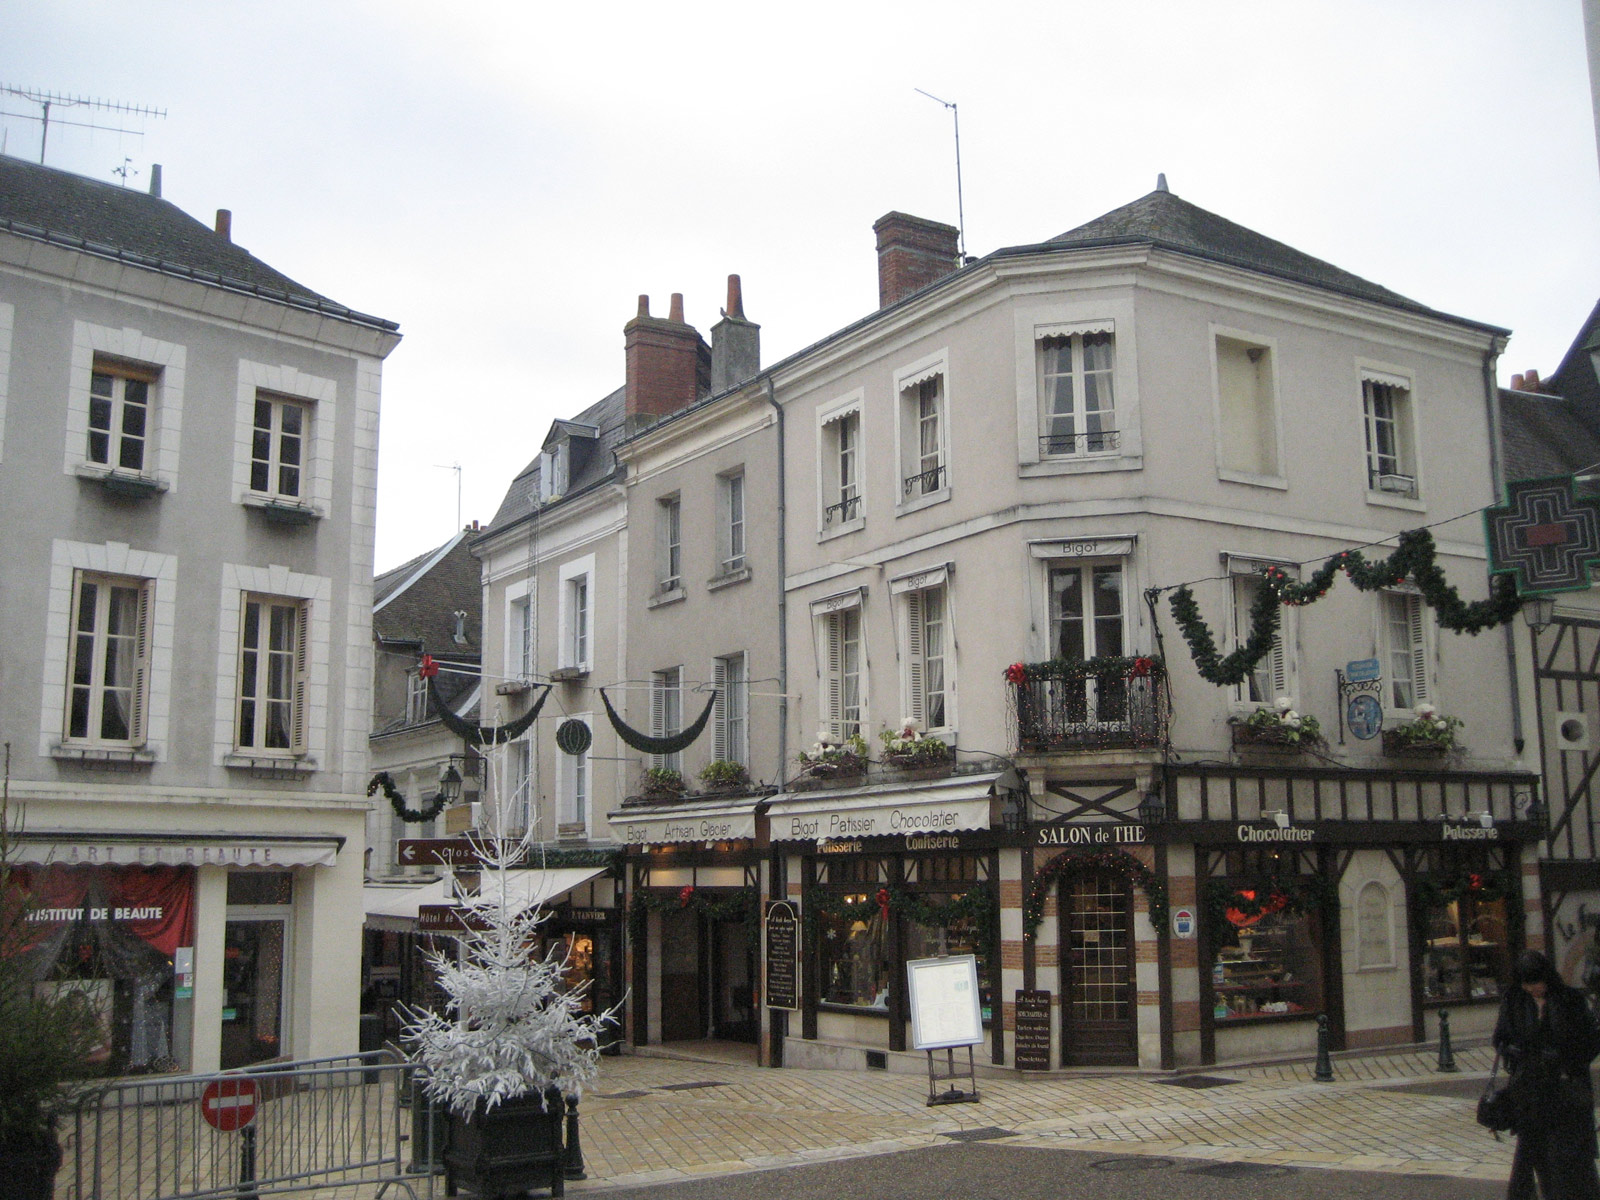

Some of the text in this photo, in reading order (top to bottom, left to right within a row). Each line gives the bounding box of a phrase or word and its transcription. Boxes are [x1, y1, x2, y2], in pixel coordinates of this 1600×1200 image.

[1062, 541, 1098, 556] Bigot
[907, 575, 928, 588] Bigot
[627, 820, 732, 843] Bigot Artisan Glacier
[792, 817, 819, 839] Bigot
[890, 809, 959, 831] Chocolatier
[1038, 825, 1146, 844] SALON de THE
[1237, 824, 1315, 842] Chocolatier
[905, 834, 959, 850] Confiserie
[71, 846, 271, 862] ART ET BEAUTE
[441, 847, 469, 858] Clos
[90, 908, 109, 921] DE
[114, 906, 163, 921] BEAUTE
[444, 912, 454, 923] de
